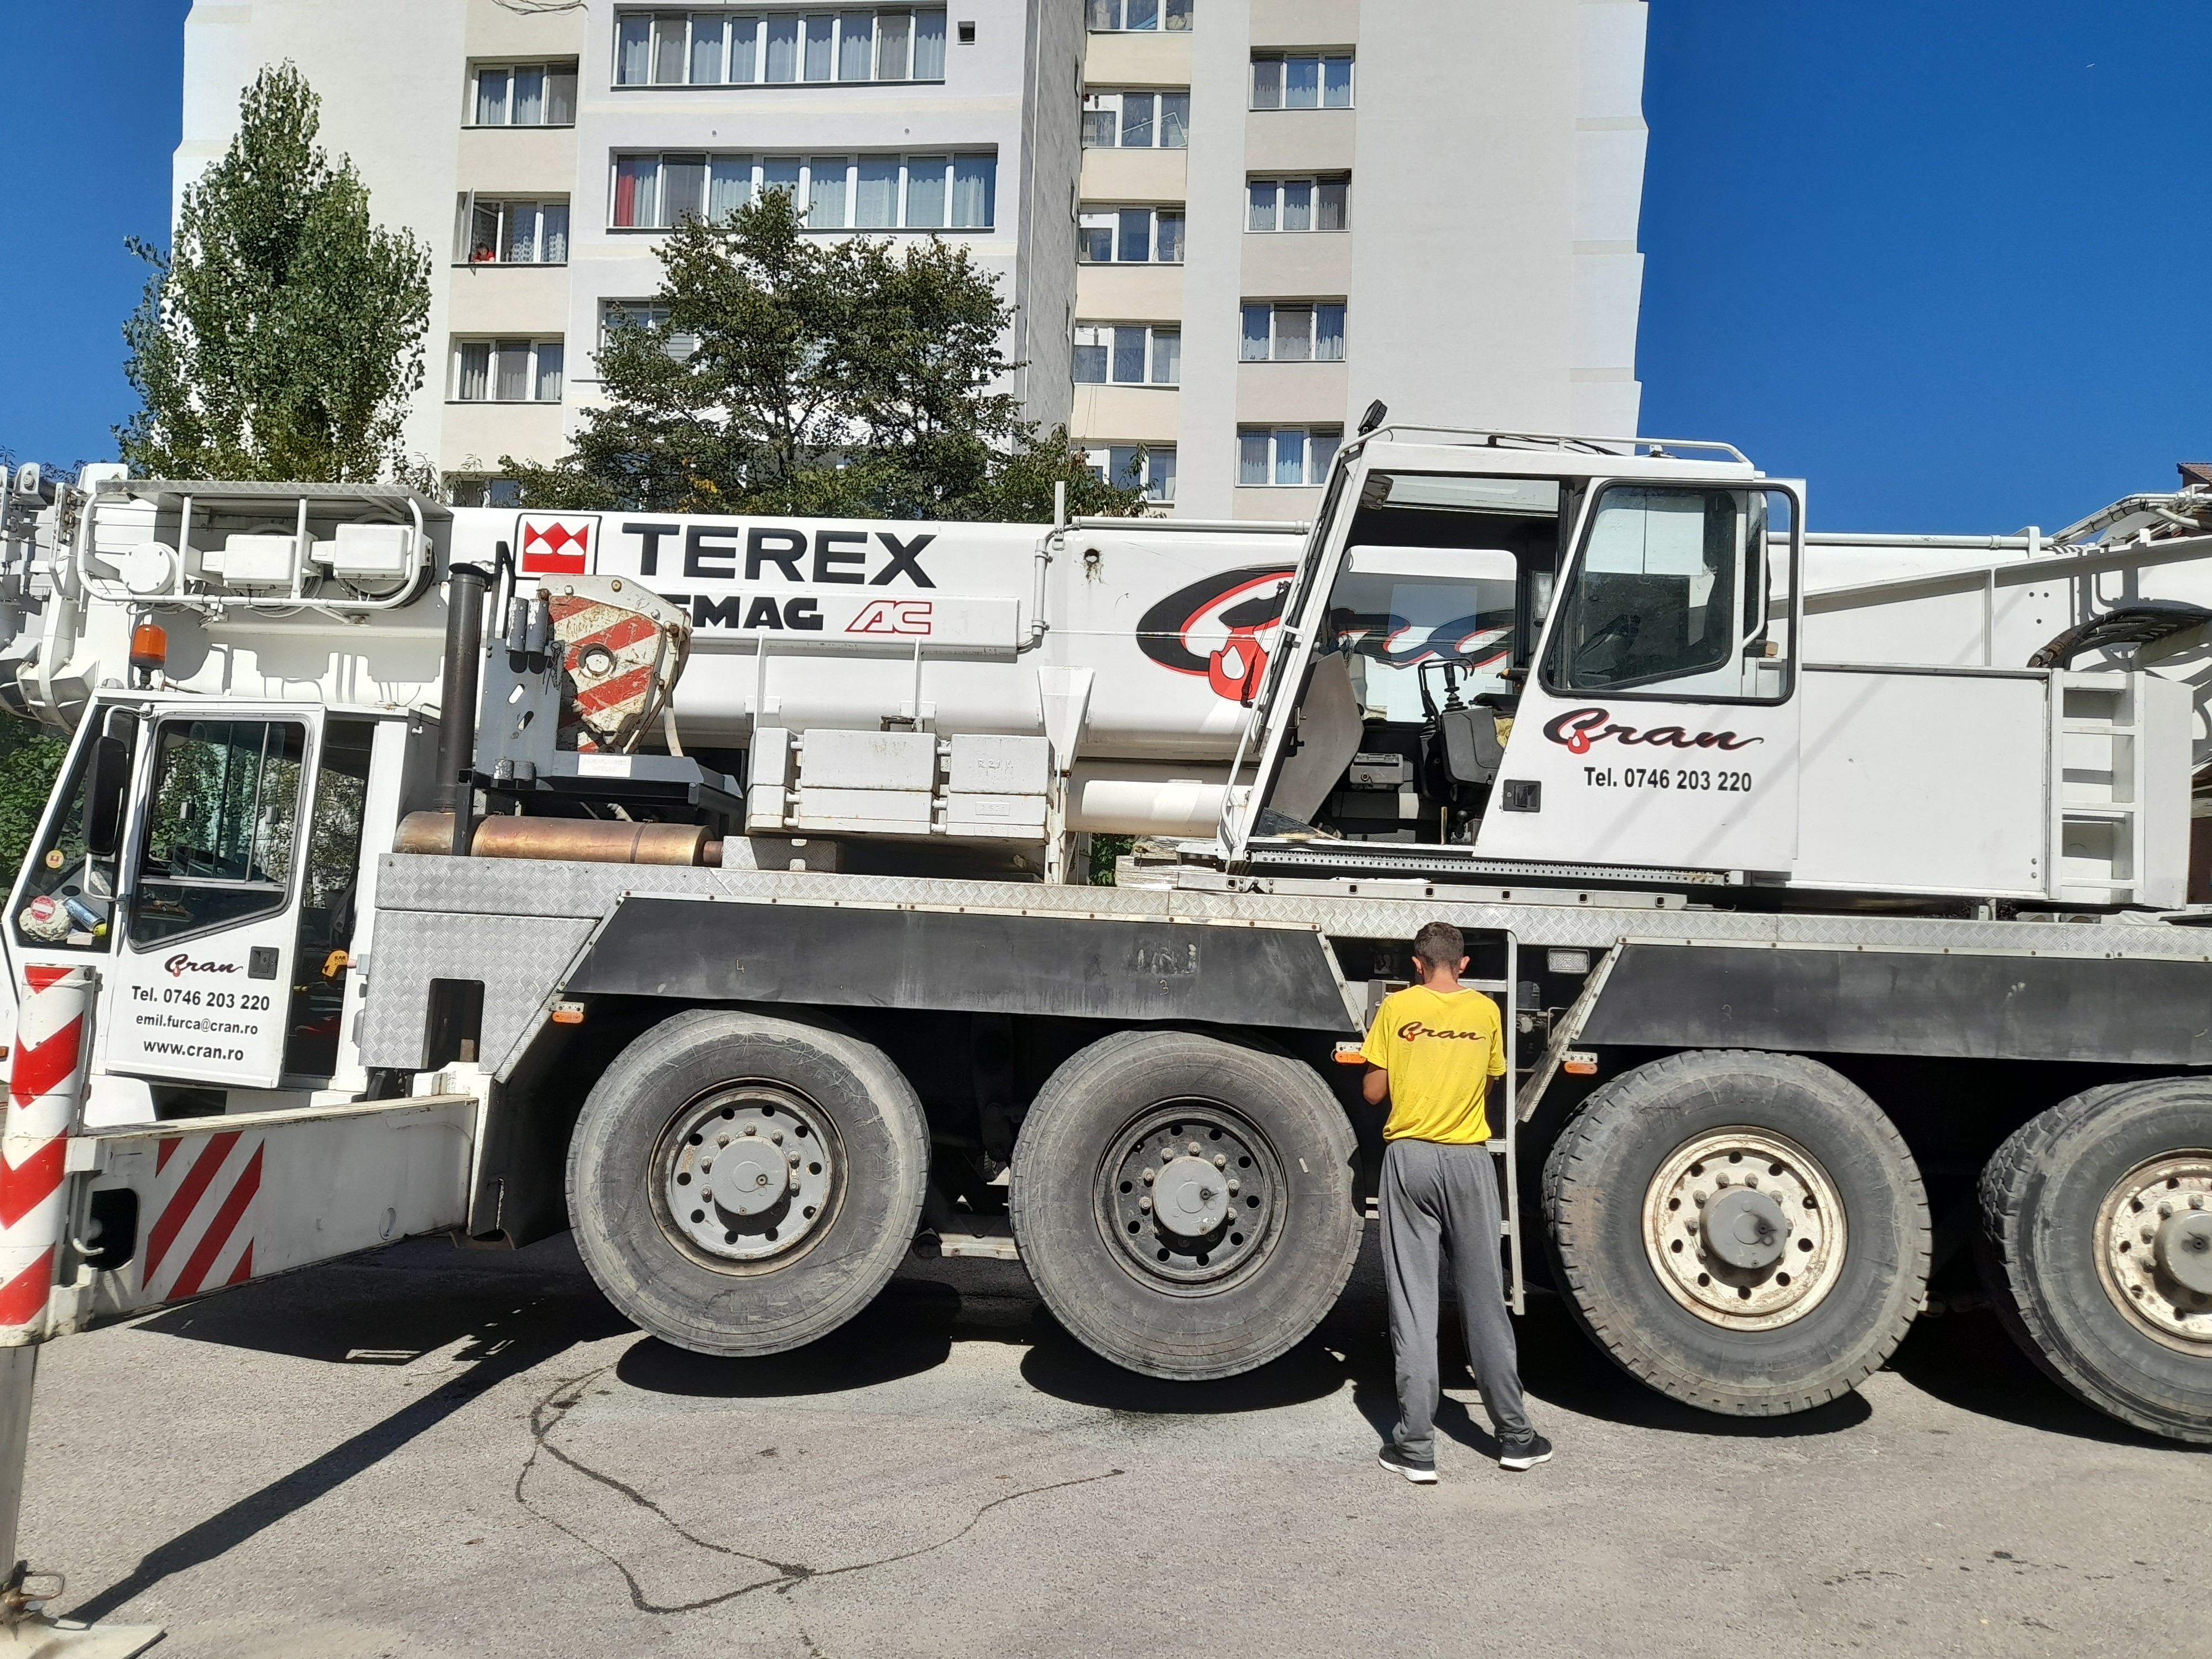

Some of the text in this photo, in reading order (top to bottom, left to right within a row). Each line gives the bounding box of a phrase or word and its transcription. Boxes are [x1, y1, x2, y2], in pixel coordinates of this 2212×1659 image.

[622, 523, 937, 588] TEREX
[658, 594, 932, 635] MAG AC
[1584, 766, 1752, 792] Tel. 0746 203 220
[736, 959, 744, 973] 4
[132, 985, 270, 1011] Tel. 0746 203 220
[1160, 980, 1169, 995] 3
[136, 1014, 258, 1035] emil.furca@cran.ro
[143, 1041, 244, 1061] www.cran.ro
